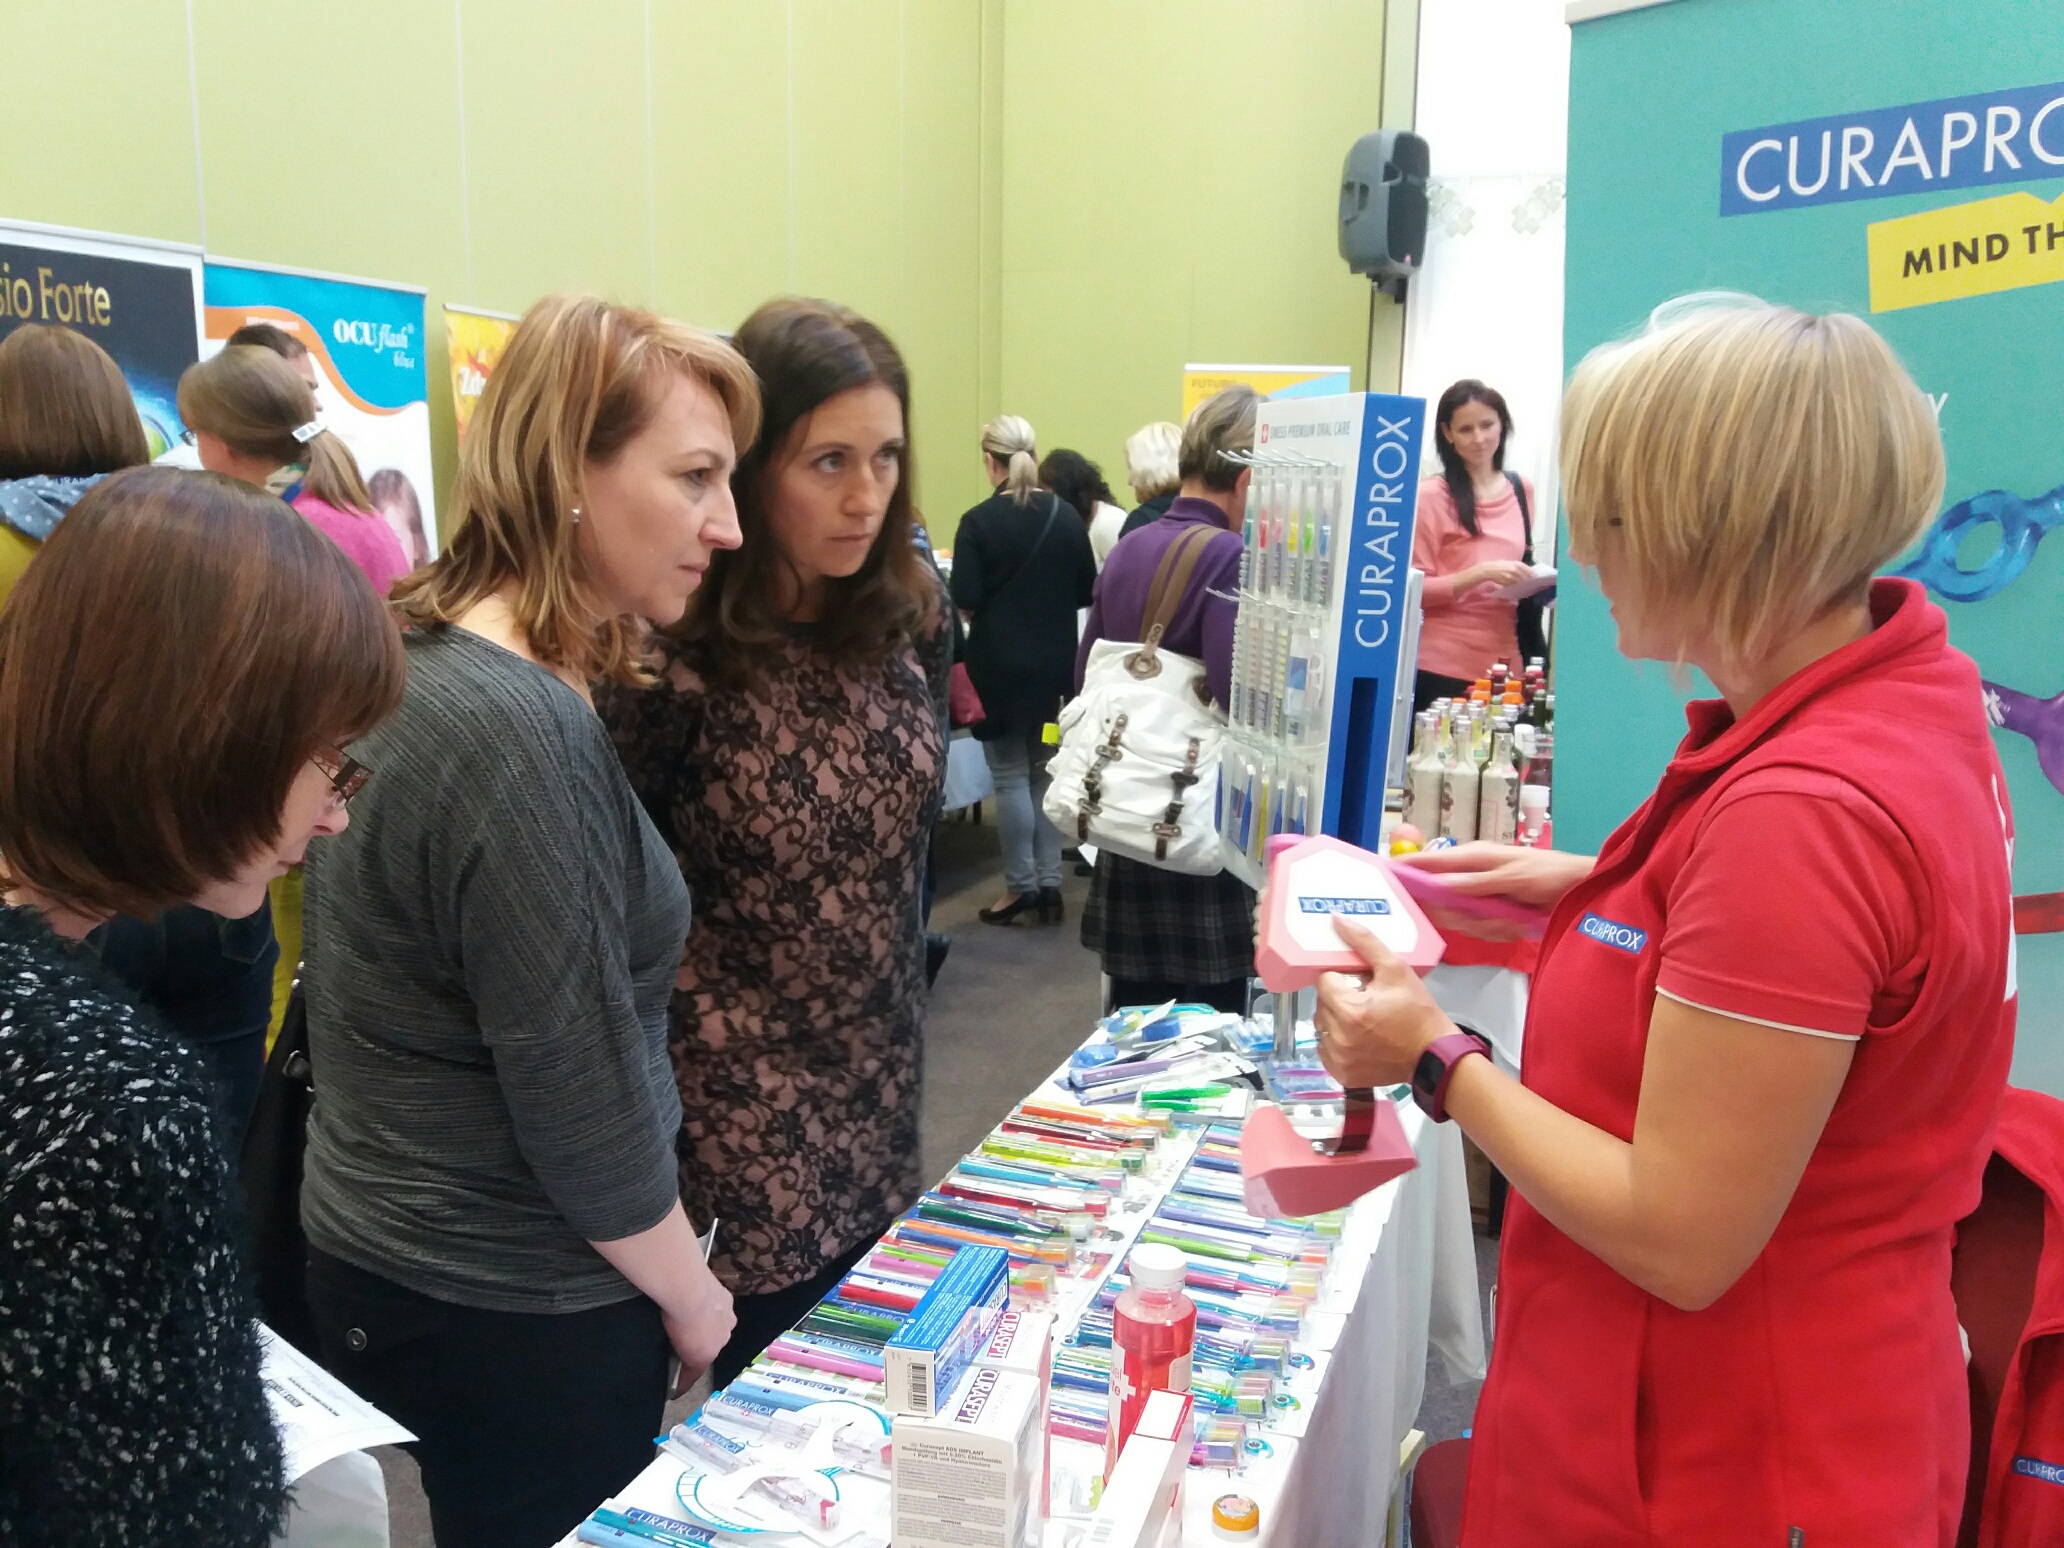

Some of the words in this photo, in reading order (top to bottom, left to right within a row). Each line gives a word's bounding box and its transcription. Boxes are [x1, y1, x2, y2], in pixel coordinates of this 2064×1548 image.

[1902, 233, 2010, 279] MIND
[37, 266, 111, 327] Forte
[1288, 423, 1316, 438] PREMIUM
[1316, 422, 1332, 437] ORAL
[1334, 420, 1351, 436] CARE
[1355, 415, 1412, 648] CURAPROX
[989, 1312, 1020, 1359] CURASEPT
[723, 1395, 775, 1416] CURAPROX
[957, 1369, 999, 1424] CURASEPT
[698, 1427, 741, 1454] CURAPROX
[627, 1509, 711, 1543] CURAPROX
